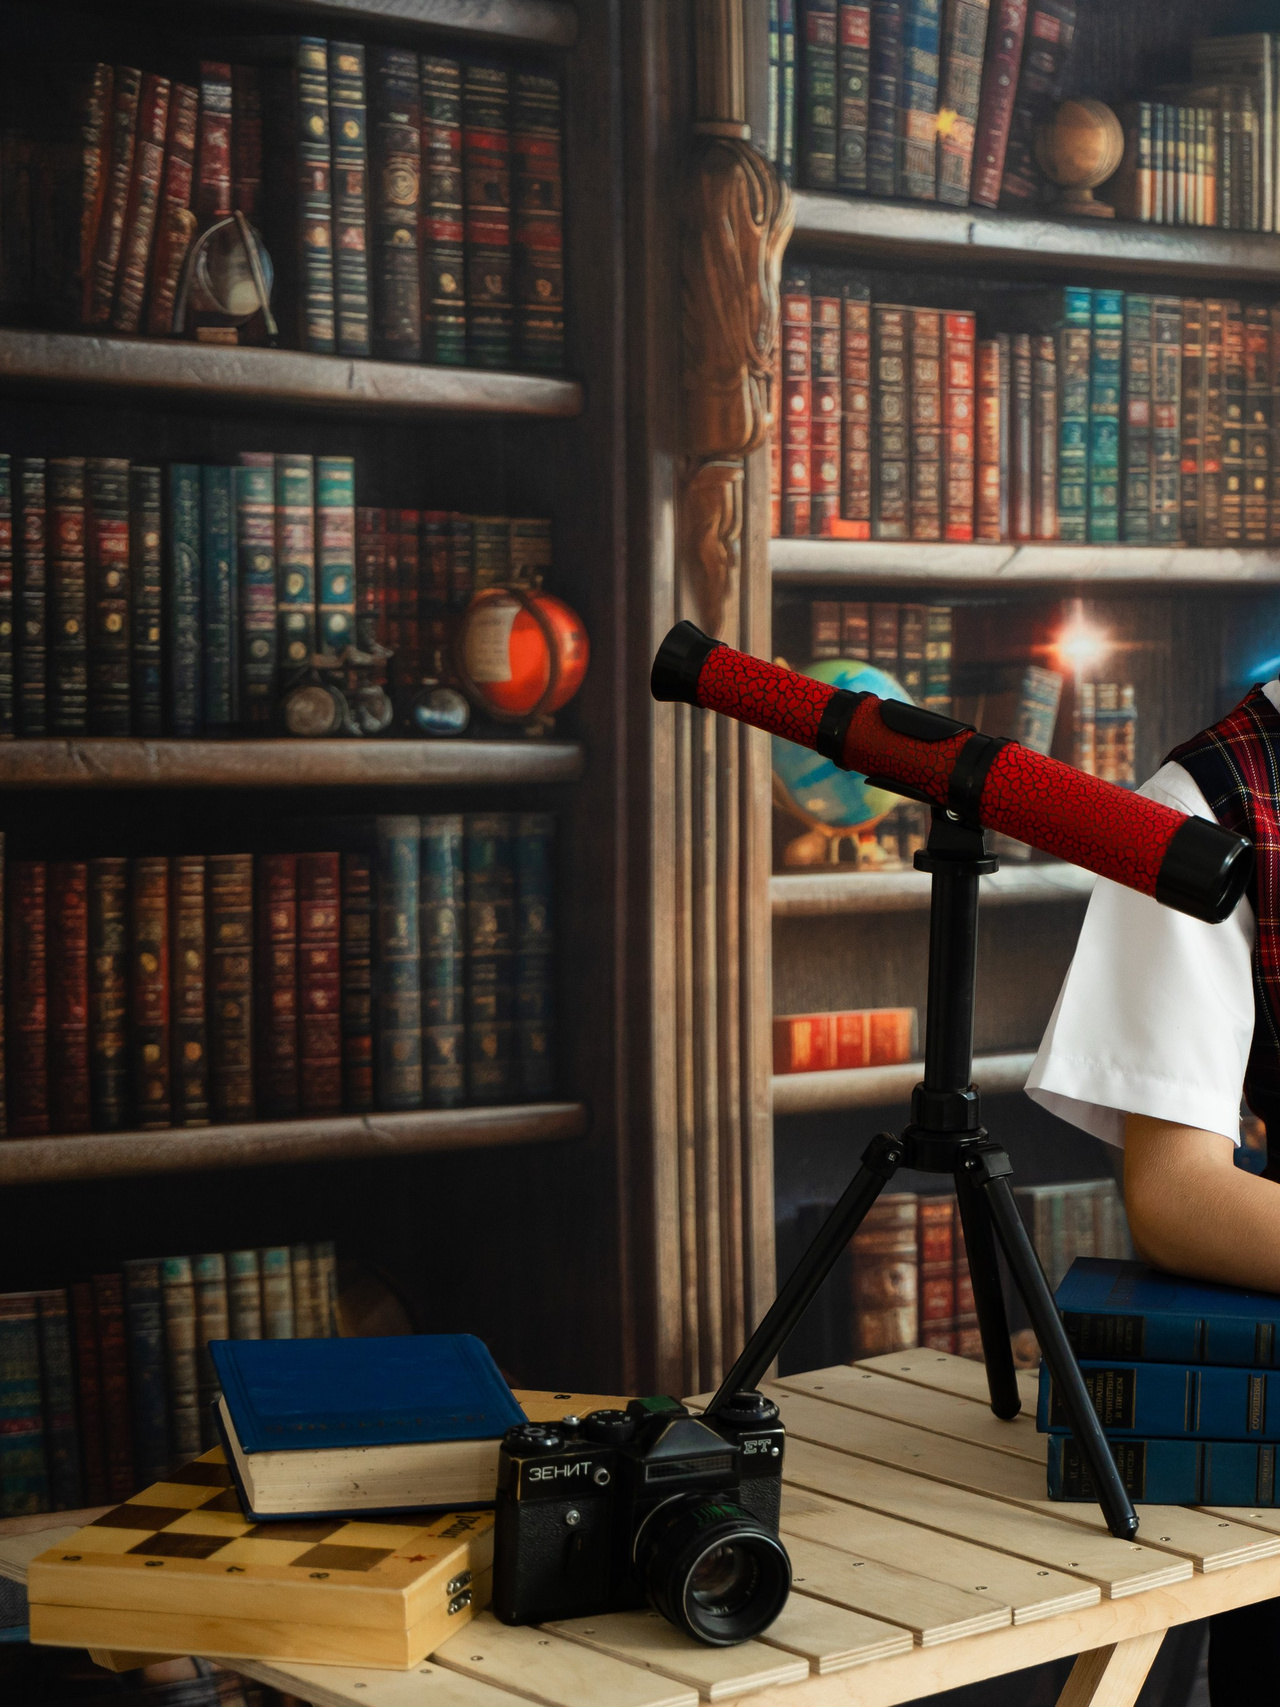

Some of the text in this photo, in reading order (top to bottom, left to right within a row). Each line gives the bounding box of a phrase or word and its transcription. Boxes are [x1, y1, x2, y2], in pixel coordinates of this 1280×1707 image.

[1105, 1371, 1114, 1424] СОЧИНЕНИЙ
[1115, 1377, 1123, 1409] ПИСЕМ
[1252, 1377, 1261, 1430] СОЧИНЕНИЯ
[528, 1461, 593, 1482] ЗЕНИТ
[61, 1554, 83, 1562] 5
